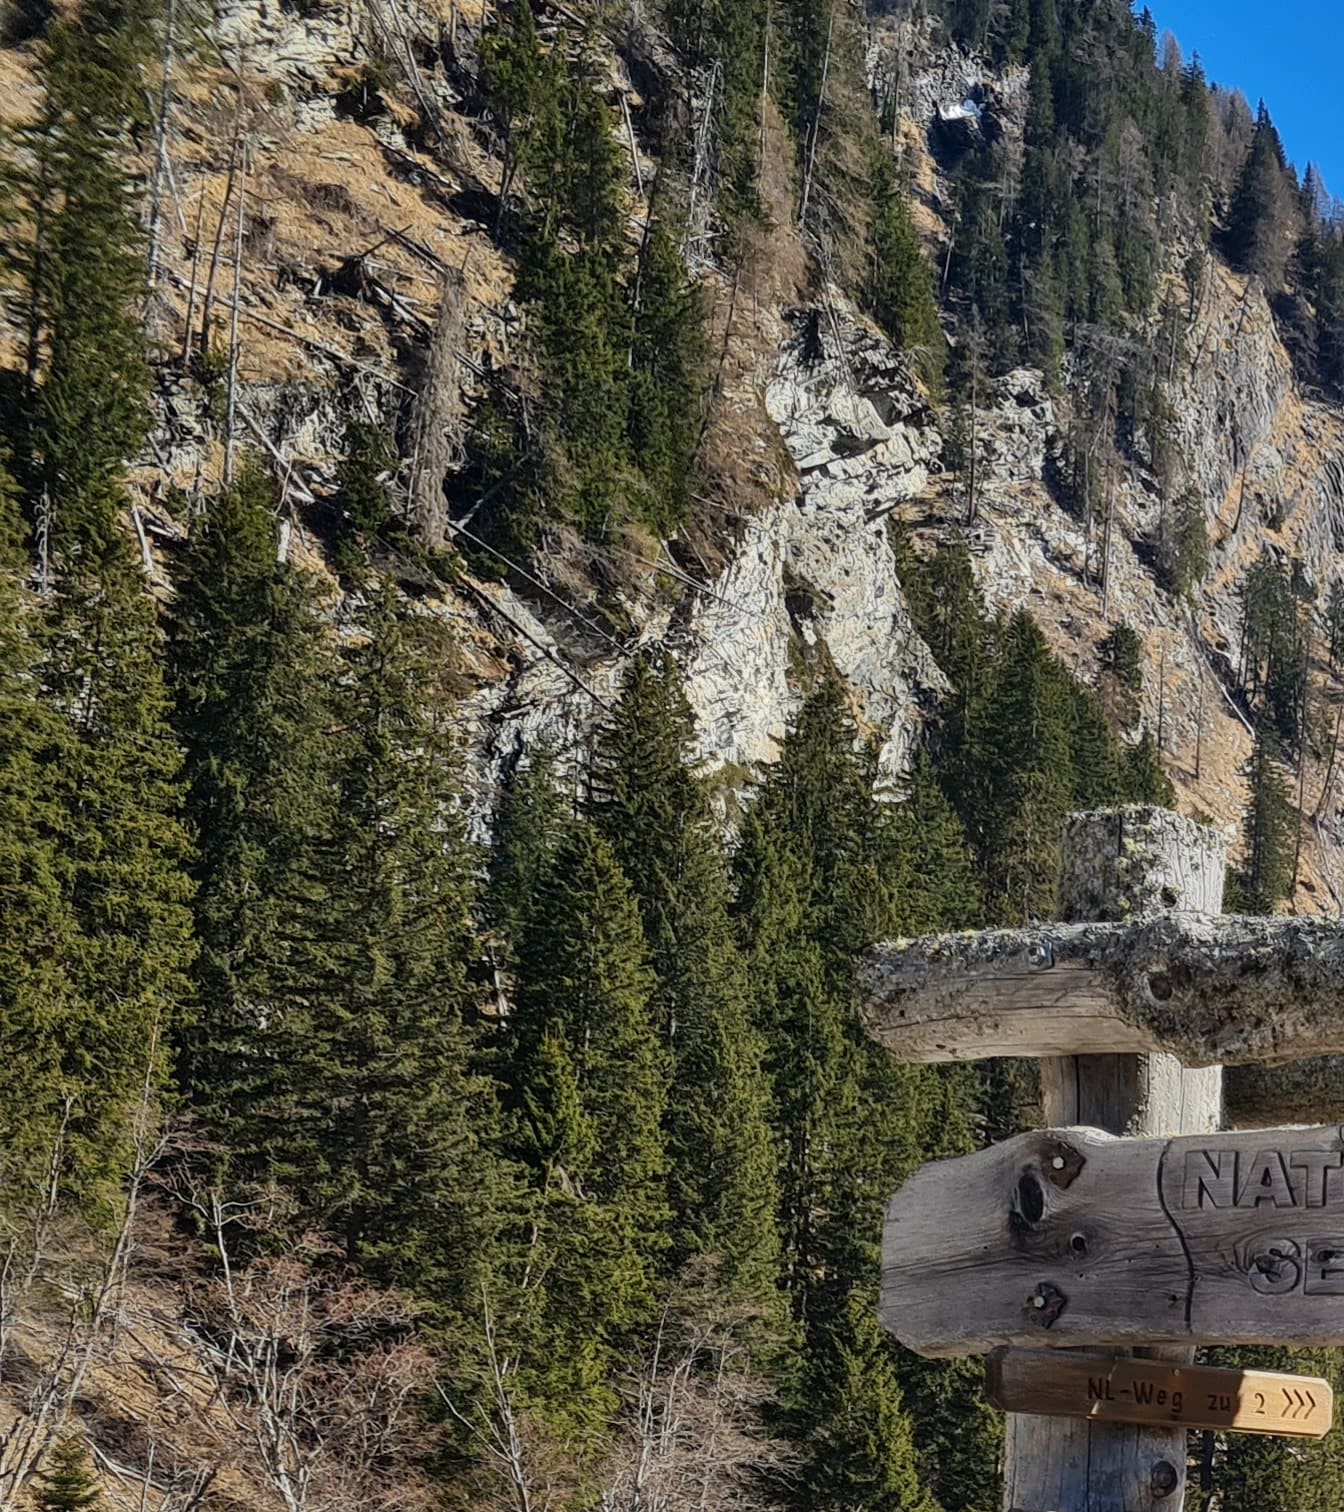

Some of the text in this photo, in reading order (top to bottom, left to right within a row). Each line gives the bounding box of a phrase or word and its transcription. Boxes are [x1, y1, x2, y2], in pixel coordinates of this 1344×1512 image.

[1087, 1377, 1266, 1415] NL-Weg zu 2
